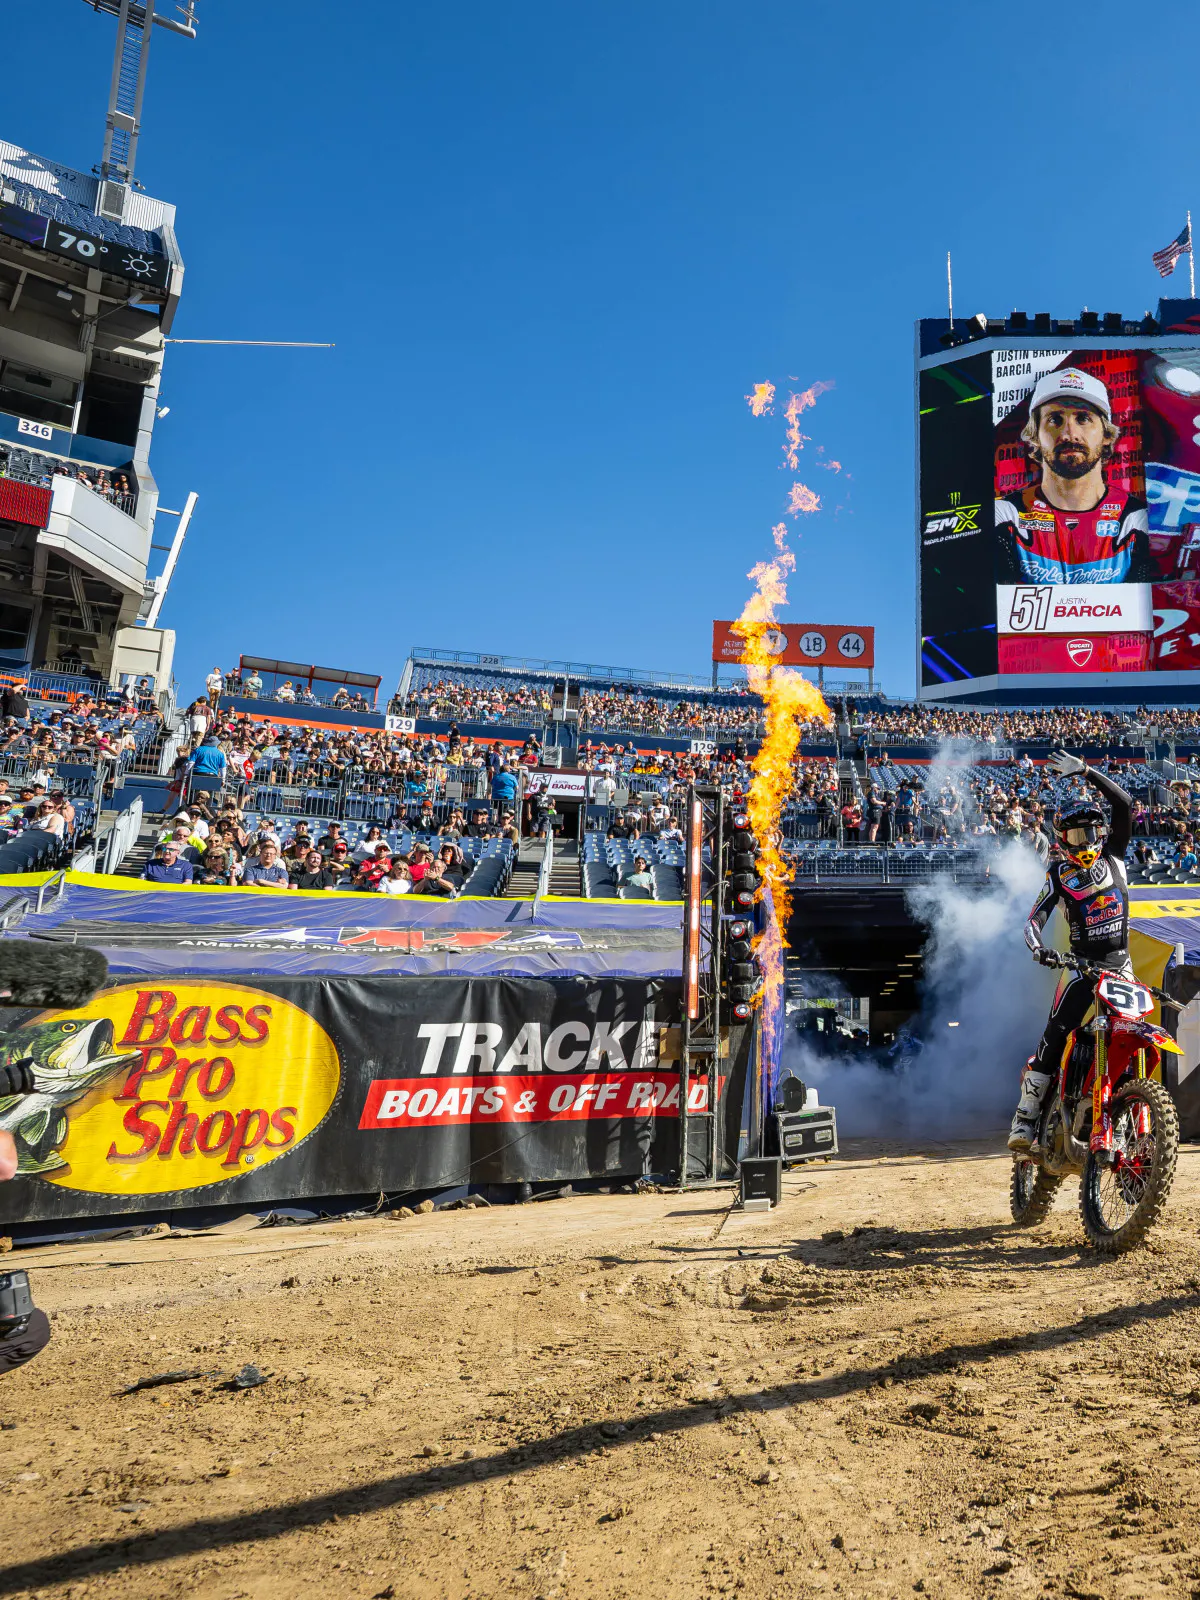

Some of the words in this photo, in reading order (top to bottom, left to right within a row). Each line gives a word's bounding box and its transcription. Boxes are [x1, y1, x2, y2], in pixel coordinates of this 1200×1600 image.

[54, 168, 77, 182] 542
[996, 362, 1032, 378] BARCIA
[20, 421, 50, 437] 346
[924, 508, 980, 534] SMX
[1068, 567, 1121, 584] Designs
[1009, 586, 1053, 631] 51
[1056, 597, 1089, 605] JUSTIN
[1053, 604, 1123, 618] BARCIA
[803, 636, 823, 652] 18
[841, 637, 861, 653] 44
[482, 656, 499, 665] 228
[848, 683, 862, 691] 230
[388, 718, 413, 731] 129
[693, 742, 714, 753] 129
[551, 783, 585, 791] BARCIA
[1086, 910, 1106, 927] Red
[1105, 902, 1122, 919] Bull
[1087, 920, 1123, 937] DUCATI
[1088, 934, 1108, 942] FACTORY
[1108, 930, 1123, 939] RACING
[177, 939, 306, 950] AMERICAN
[1106, 982, 1147, 1013] 51
[116, 990, 272, 1047] Bass
[113, 1046, 236, 1101] Pro
[376, 1086, 506, 1120] BOATS
[512, 1089, 538, 1115] &
[547, 1083, 621, 1113] OFF
[626, 1081, 710, 1110] ROAD
[106, 1100, 299, 1167] Shops
